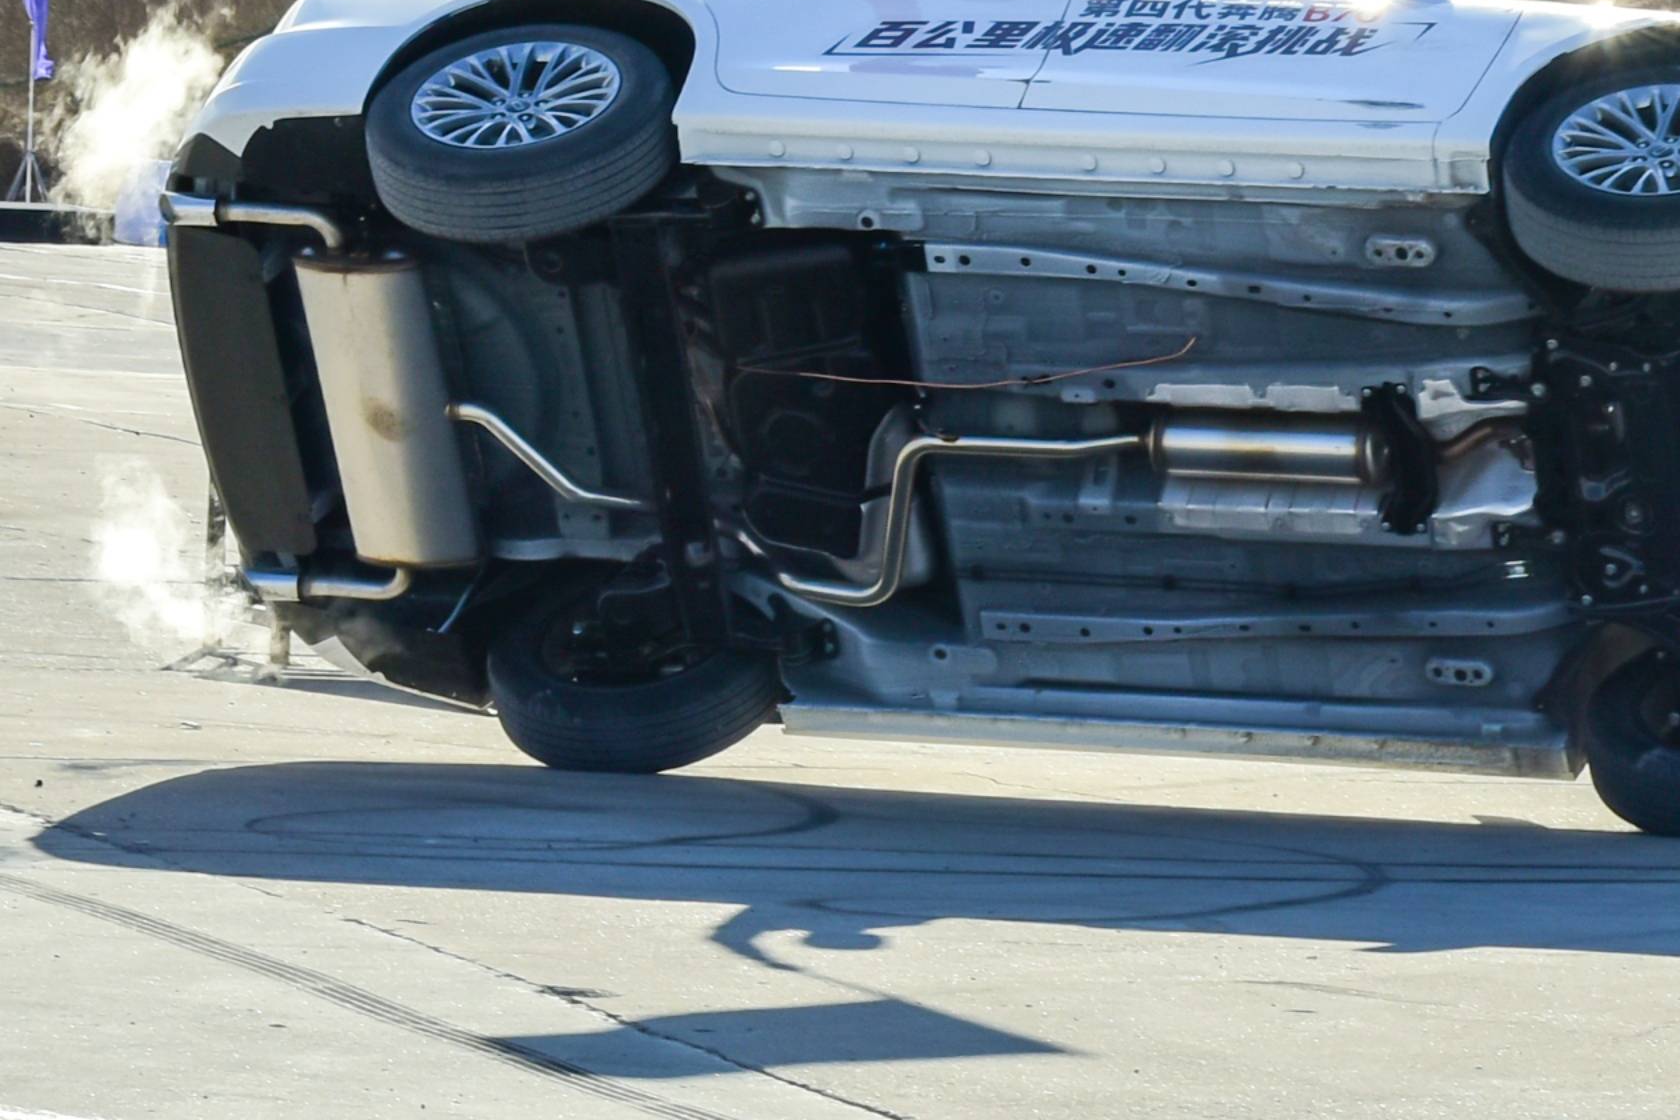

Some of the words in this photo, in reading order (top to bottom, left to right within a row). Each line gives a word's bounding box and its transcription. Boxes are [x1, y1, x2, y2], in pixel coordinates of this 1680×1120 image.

[853, 20, 1380, 61] 百公里极速翻滚挑战
